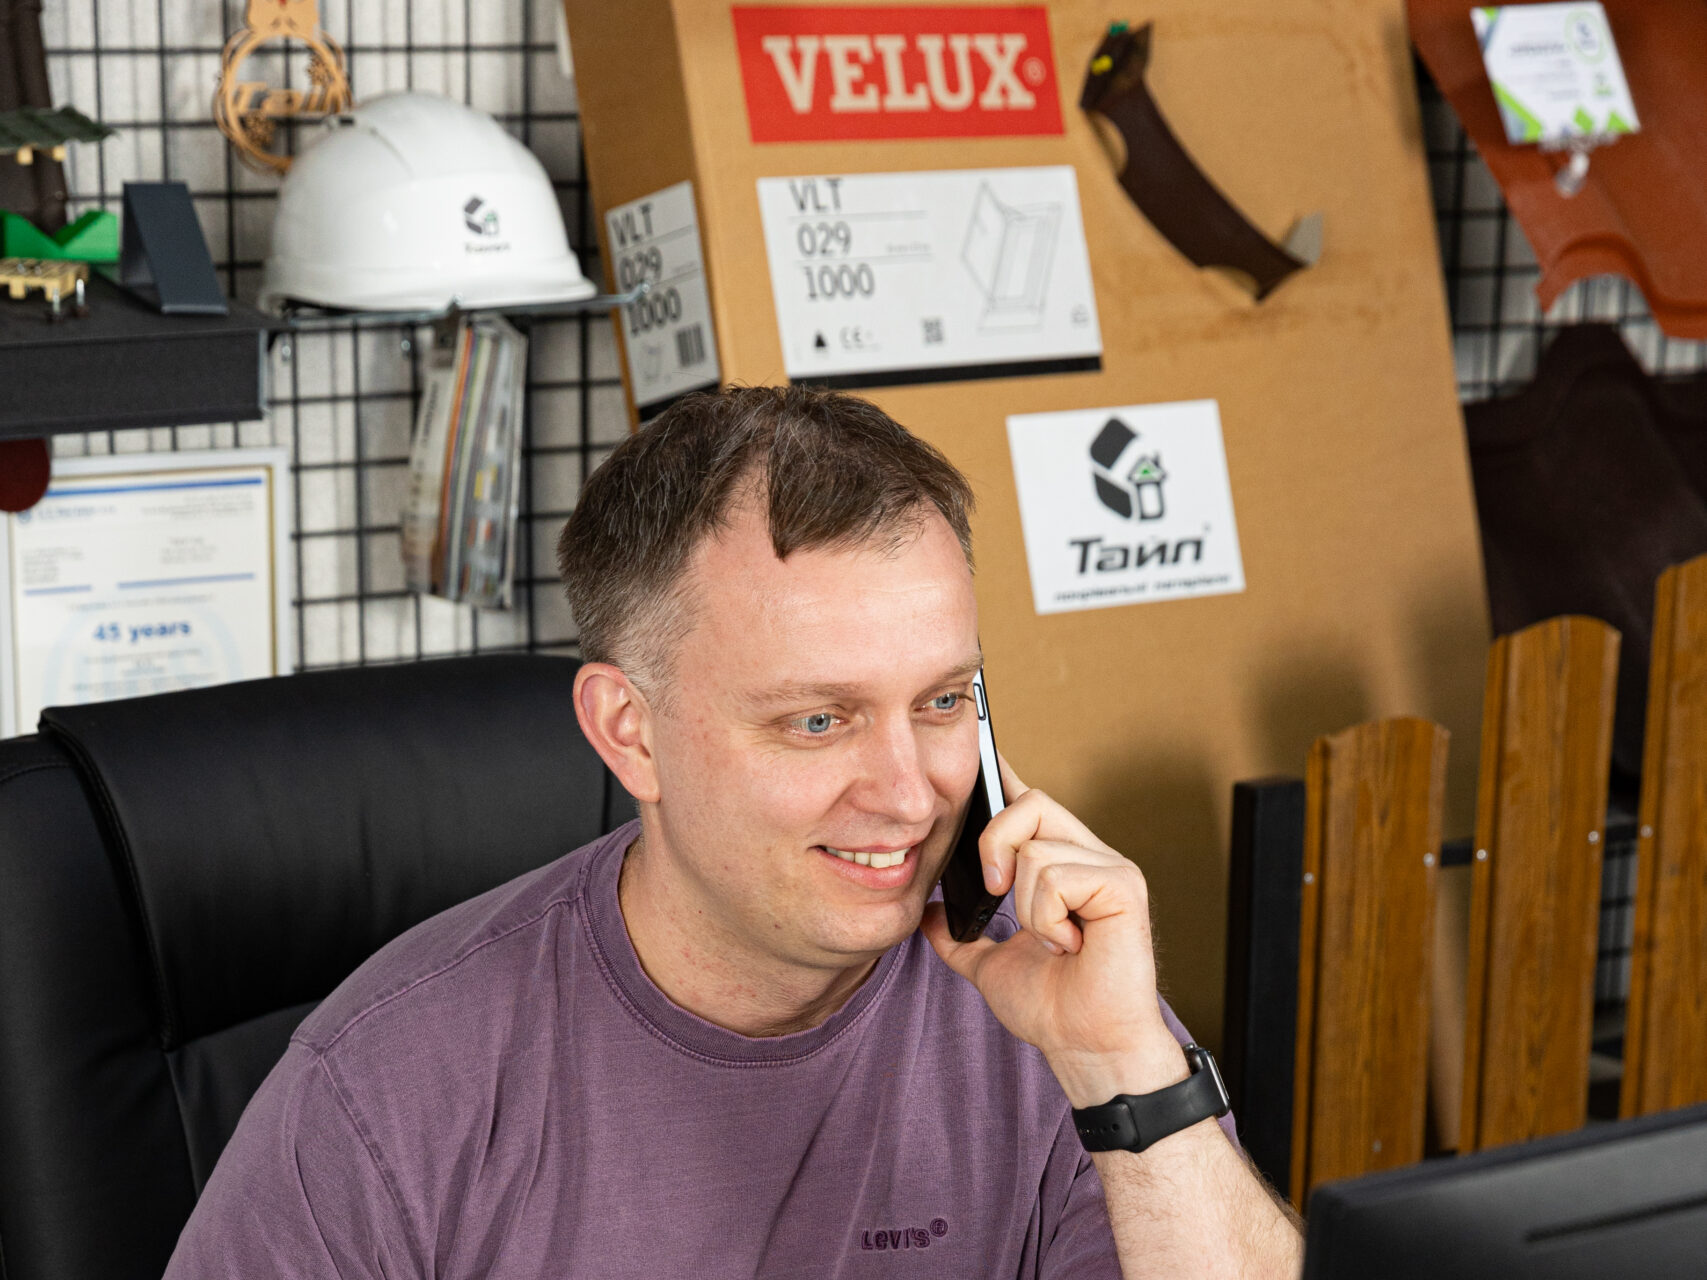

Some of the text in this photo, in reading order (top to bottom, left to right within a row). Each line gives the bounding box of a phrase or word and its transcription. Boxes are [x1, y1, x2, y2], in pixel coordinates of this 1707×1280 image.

[762, 34, 1036, 114] VELUX
[788, 178, 842, 212] VLT
[611, 202, 654, 246] VLT
[797, 220, 852, 258] 029
[619, 246, 663, 291] 029
[803, 262, 875, 302] 1000
[626, 286, 682, 336] 1000
[94, 620, 192, 645] 45 years
